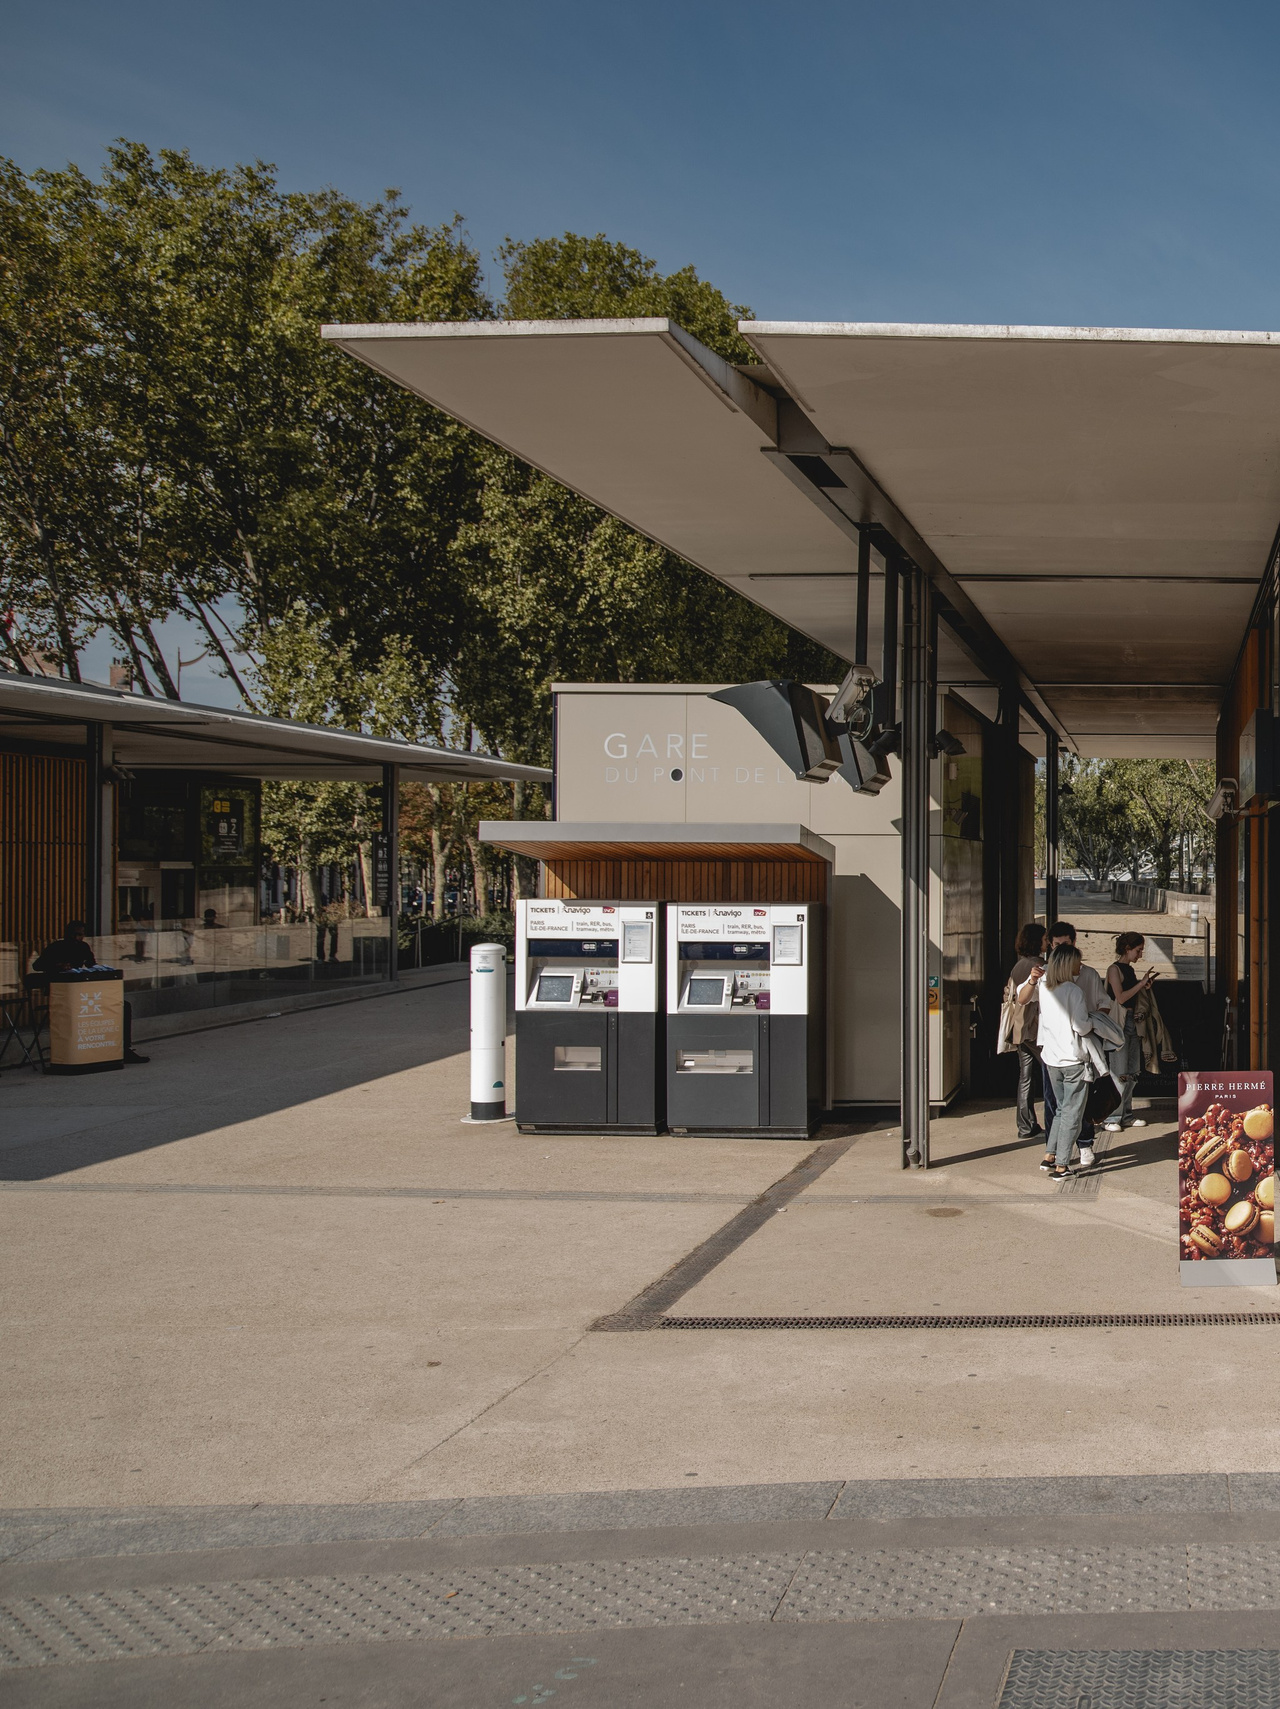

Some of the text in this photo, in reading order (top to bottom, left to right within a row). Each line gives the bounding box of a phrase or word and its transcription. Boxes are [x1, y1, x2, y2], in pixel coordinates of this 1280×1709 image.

[604, 733, 708, 759] GARE
[605, 767, 638, 783] DU
[735, 767, 765, 783] DE
[1186, 1081, 1266, 1090] PIERRE HERMÉ
